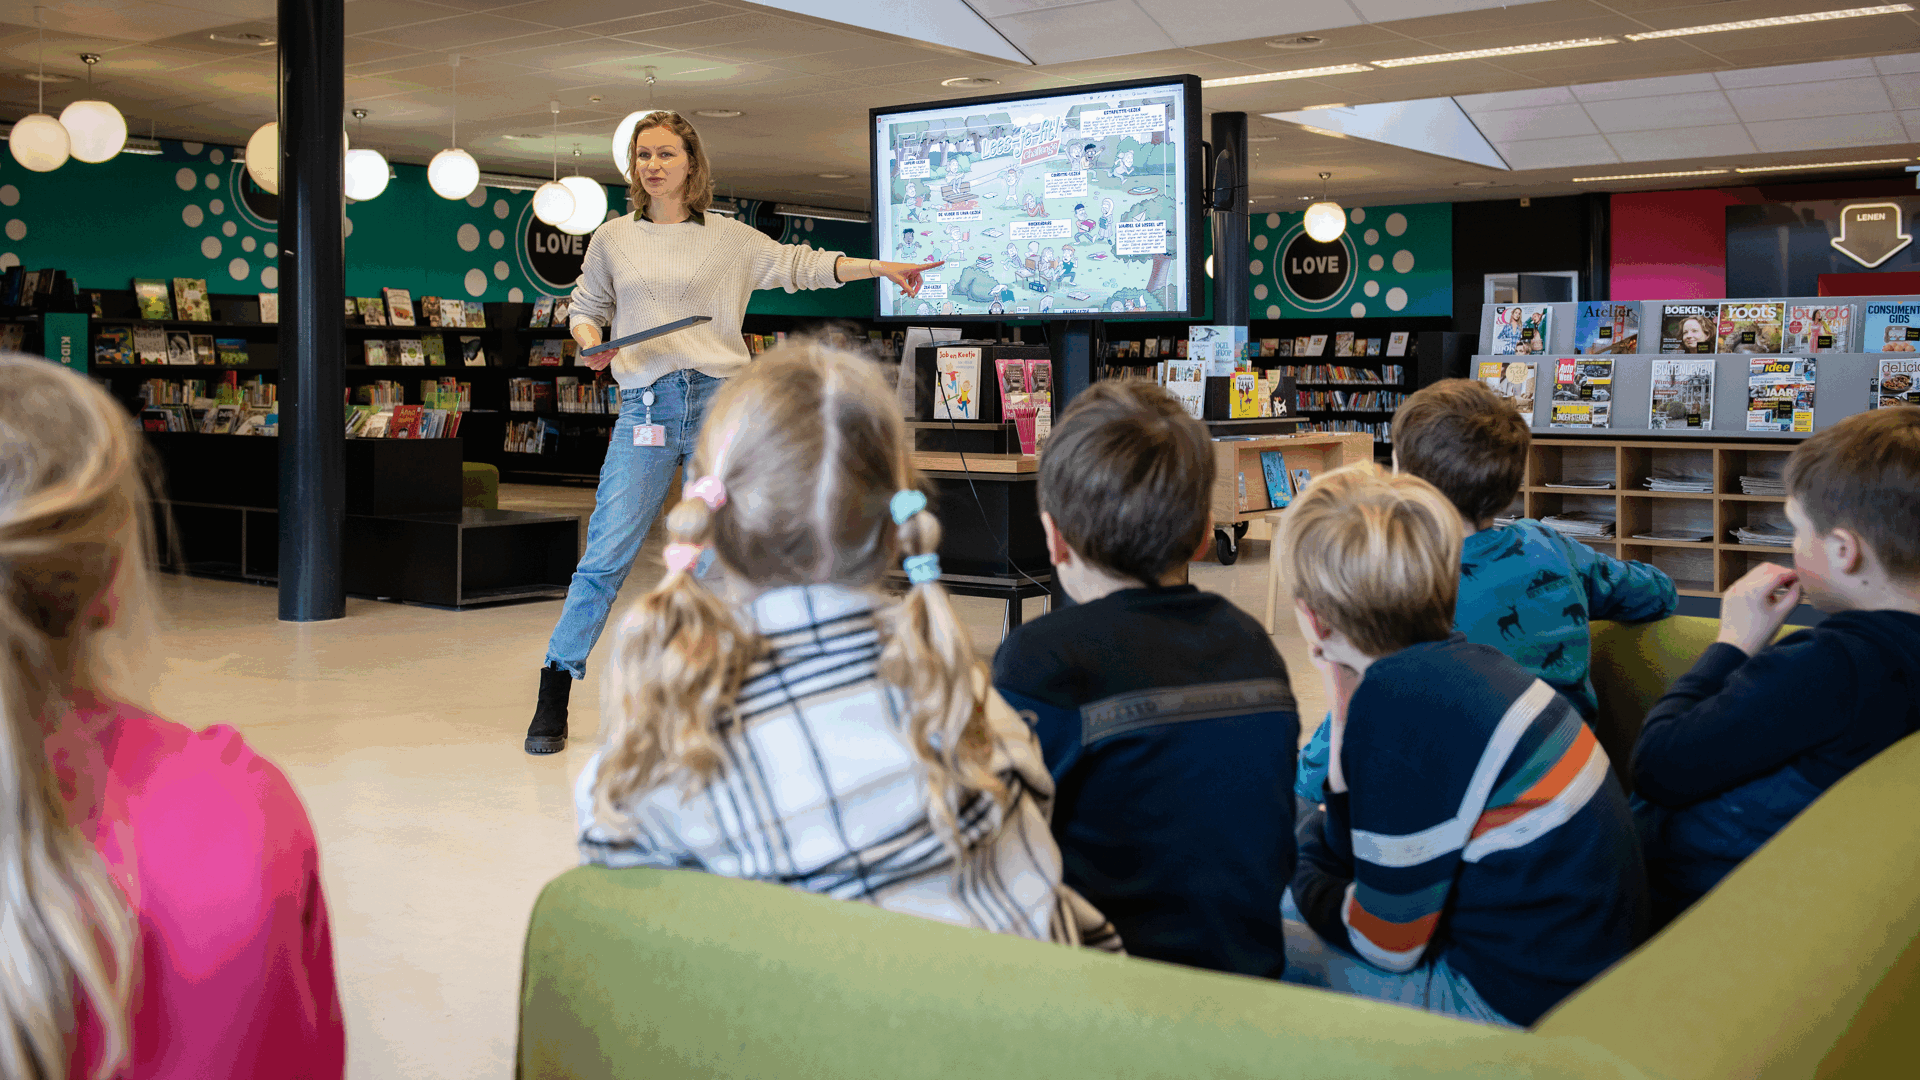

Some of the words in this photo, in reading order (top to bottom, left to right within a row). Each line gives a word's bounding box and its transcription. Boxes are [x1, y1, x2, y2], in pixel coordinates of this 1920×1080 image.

[981, 115, 1061, 160] Lees-je-fit!
[1856, 213, 1886, 221] LENEN
[535, 232, 583, 255] LOVE
[1292, 255, 1340, 275] LOVE
[1584, 304, 1633, 318] Atelier
[1665, 306, 1705, 315] BOEKEN
[1728, 304, 1777, 319] roots
[1889, 314, 1910, 323] GIDS
[61, 336, 71, 363] KIDS
[1559, 364, 1574, 373] Auto
[1655, 363, 1711, 375] BUITENLEVEN
[1766, 388, 1794, 397] JAAR
